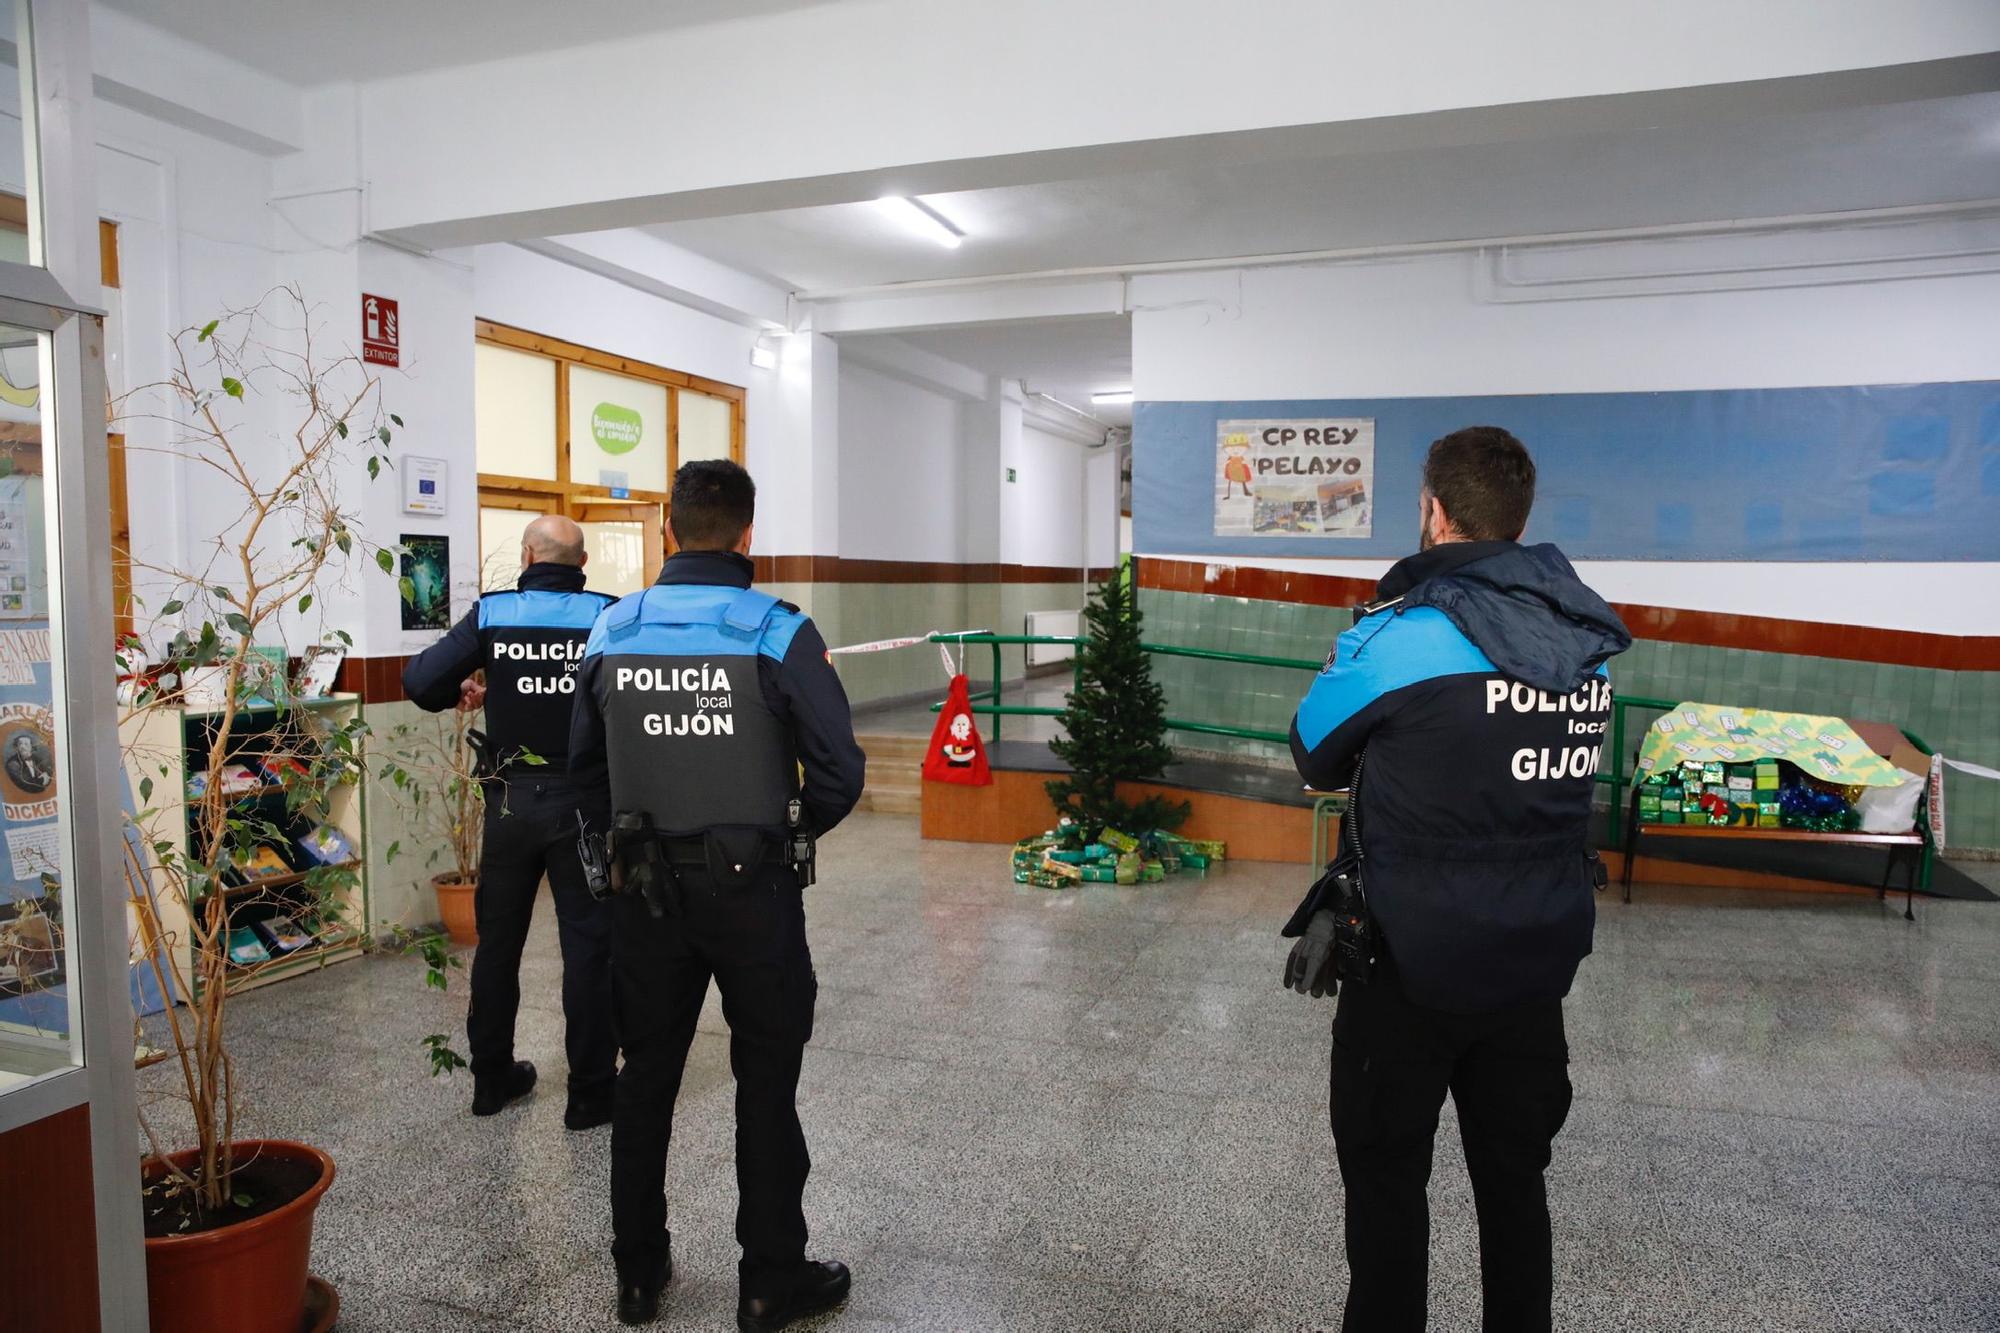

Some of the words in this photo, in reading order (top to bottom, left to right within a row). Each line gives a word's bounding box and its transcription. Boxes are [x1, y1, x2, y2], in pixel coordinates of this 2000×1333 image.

[365, 347, 398, 362] EXTINTOR
[1262, 428, 1297, 446] CP
[1304, 427, 1359, 446] REY
[1257, 456, 1361, 475] PELAYO
[517, 673, 576, 694] GIJÓ
[616, 663, 732, 692] POLICÍA
[696, 693, 732, 708] local
[643, 709, 734, 736] GIJÓN
